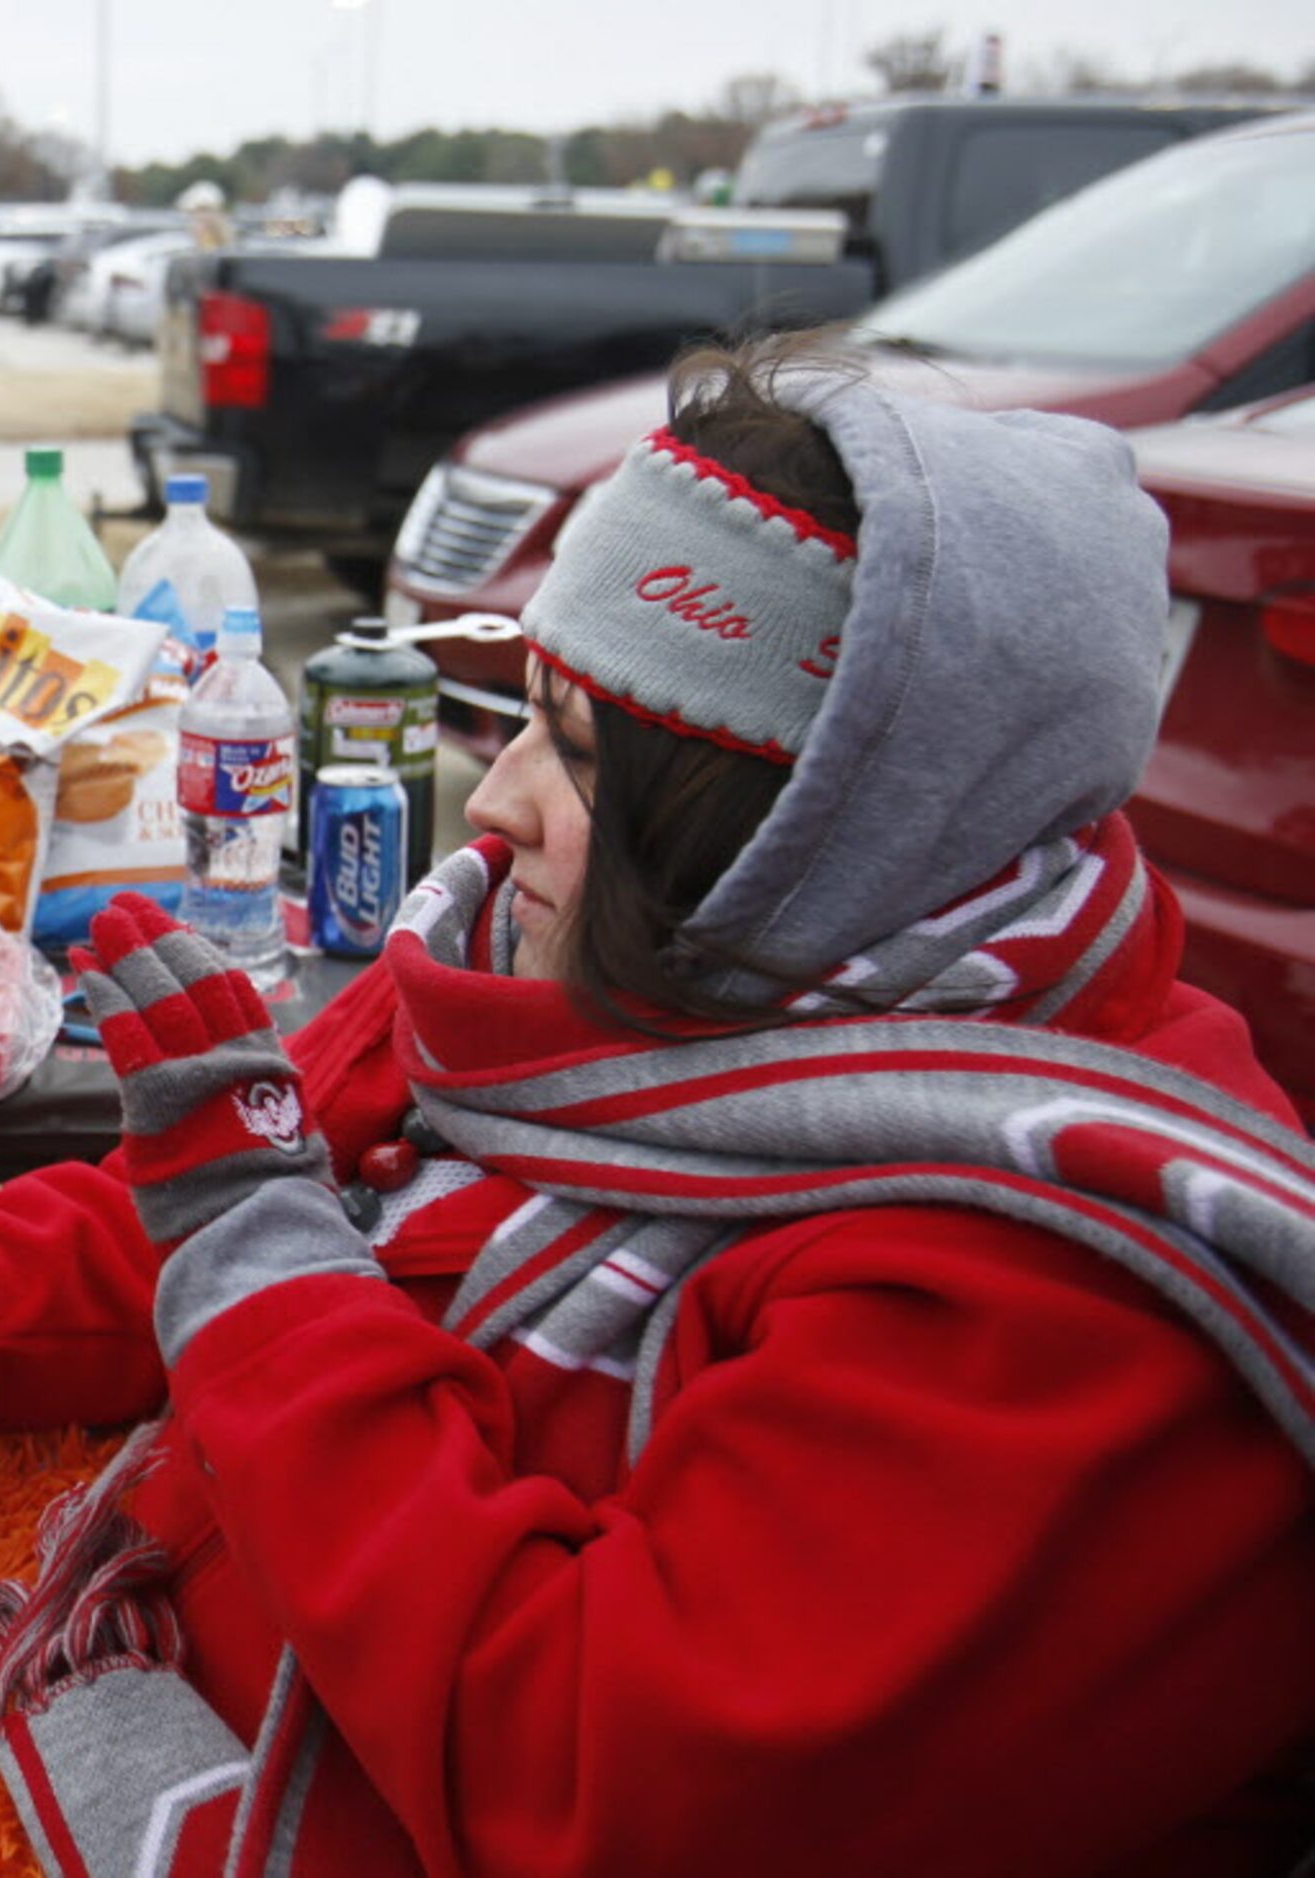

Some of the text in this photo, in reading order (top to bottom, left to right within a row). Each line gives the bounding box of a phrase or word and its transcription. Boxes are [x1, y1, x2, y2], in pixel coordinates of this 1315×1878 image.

[636, 565, 842, 679] Ohio S
[336, 824, 359, 907] BUD
[358, 813, 381, 923] LIGHT
